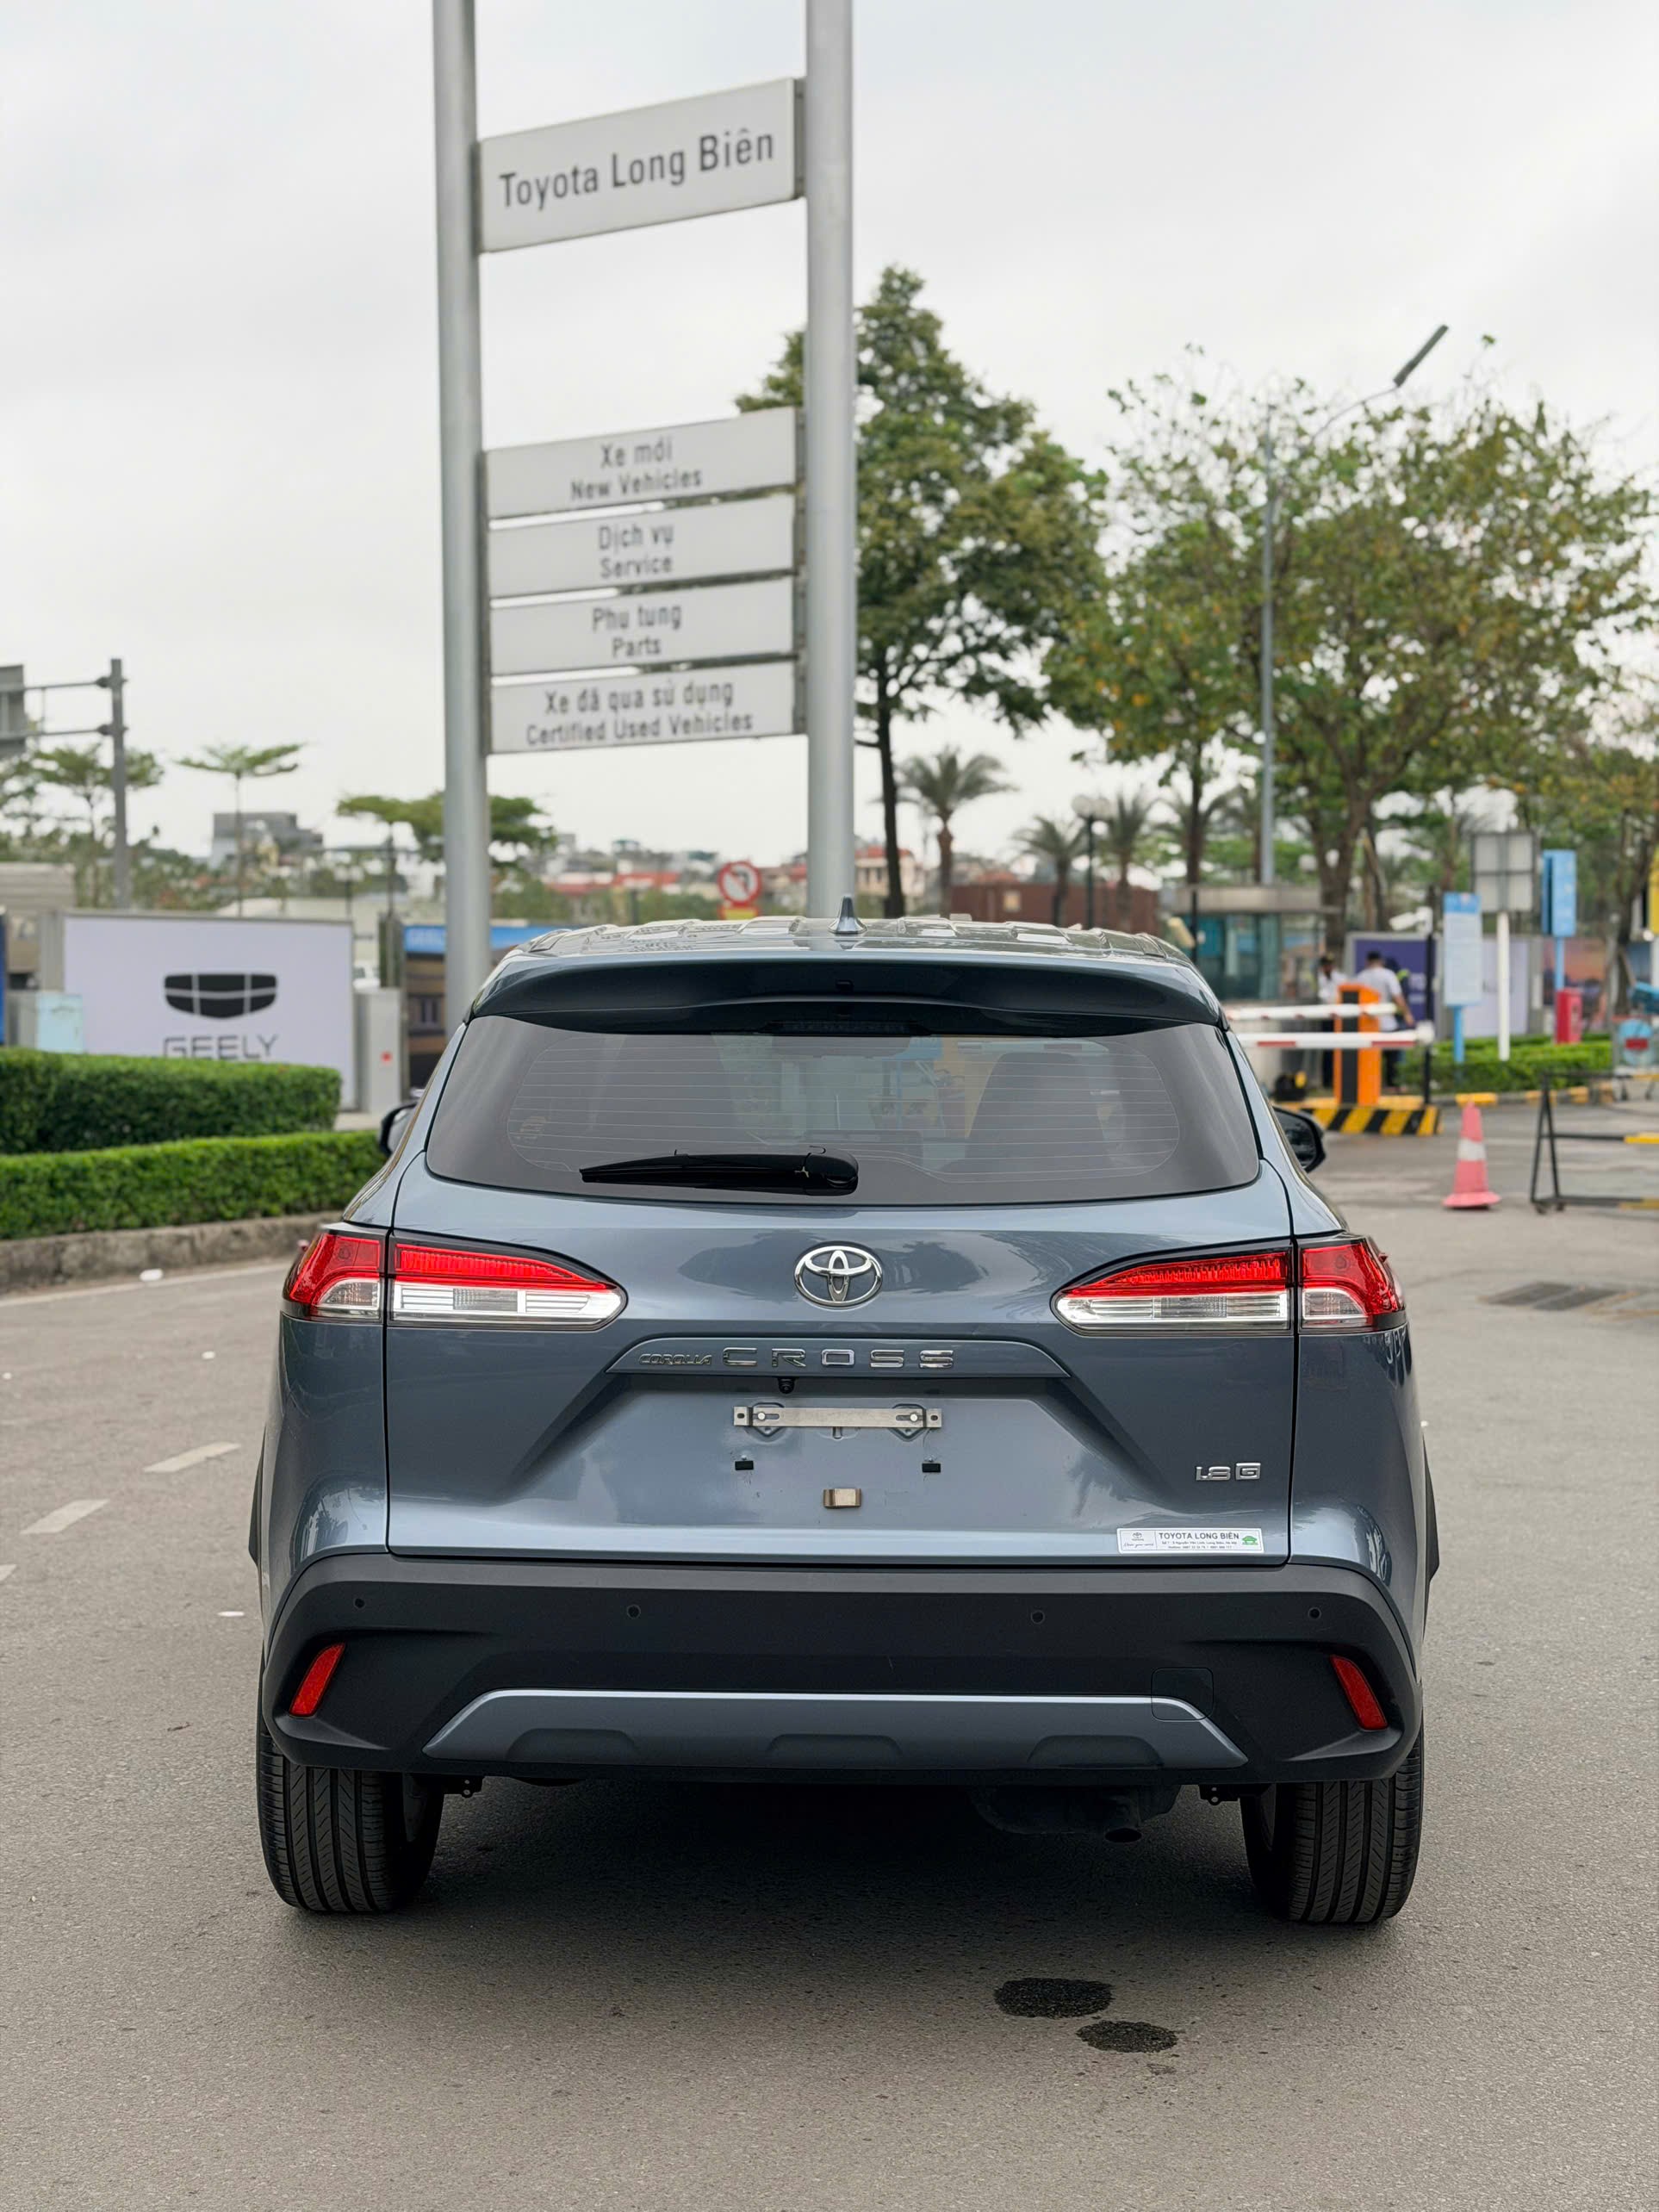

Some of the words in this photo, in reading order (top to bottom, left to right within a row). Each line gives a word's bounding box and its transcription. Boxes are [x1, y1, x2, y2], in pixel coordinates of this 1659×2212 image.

[500, 165, 599, 211] Toyota
[612, 149, 686, 189] Long
[699, 127, 774, 171] Biên
[600, 444, 626, 469] Xe
[570, 479, 612, 501] New
[618, 468, 703, 494] Vehicles
[600, 555, 673, 580] Service
[612, 636, 662, 658] Parts
[544, 690, 569, 716] Xe
[607, 689, 644, 715] qua
[526, 720, 606, 746] Certified
[612, 718, 661, 740] Used
[668, 711, 754, 736] Vehicles
[163, 1034, 279, 1060] GEELY
[638, 1353, 713, 1366] COROLLA
[722, 1346, 955, 1370] CROSS
